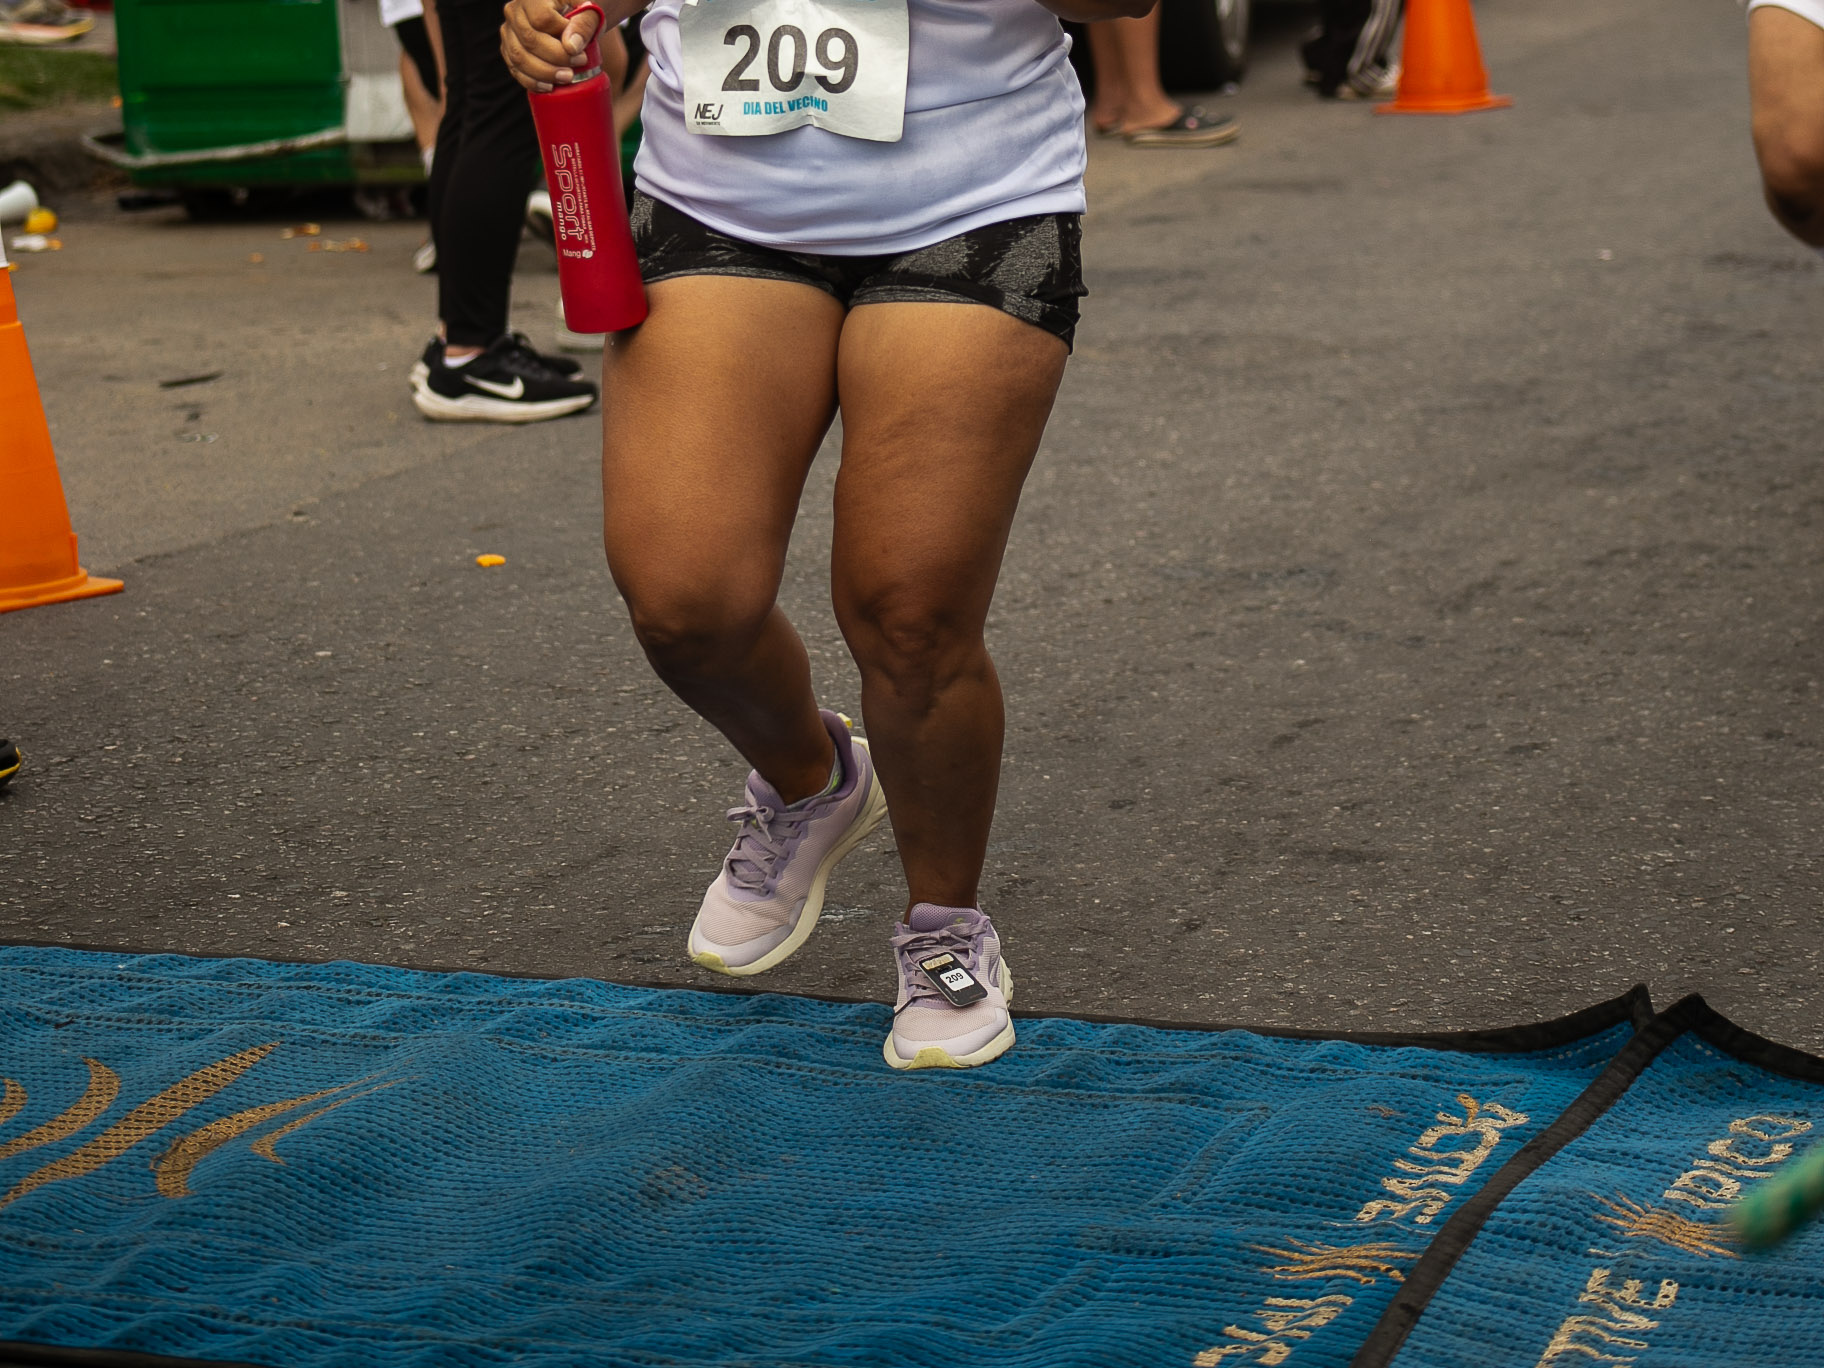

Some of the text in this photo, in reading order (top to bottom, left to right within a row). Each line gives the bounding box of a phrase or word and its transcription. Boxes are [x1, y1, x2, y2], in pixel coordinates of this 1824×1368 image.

[721, 24, 859, 94] 209
[743, 95, 828, 115] DIA DEL VECINO
[556, 201, 567, 241] mango
[945, 972, 964, 984] 209
[1535, 1268, 1680, 1368] TIVE
